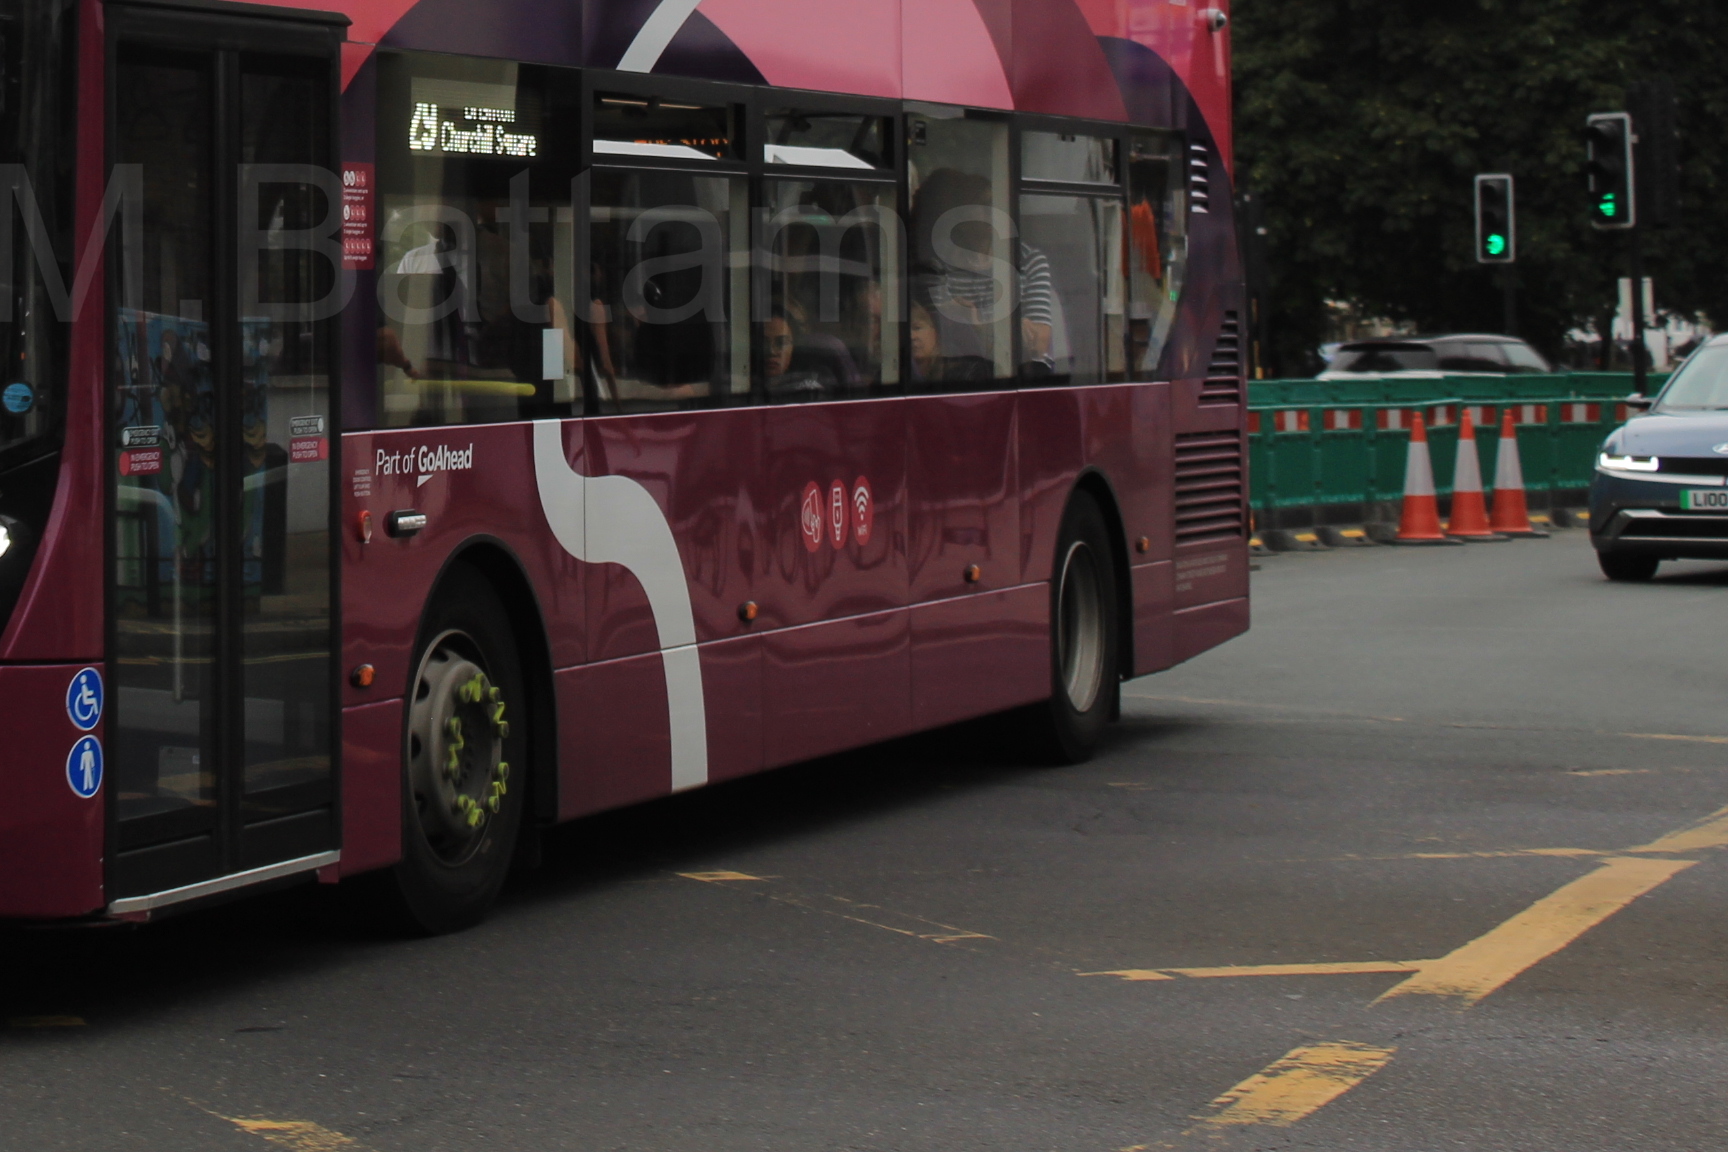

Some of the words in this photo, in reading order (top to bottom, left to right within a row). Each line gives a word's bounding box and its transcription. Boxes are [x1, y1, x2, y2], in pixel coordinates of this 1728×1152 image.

[375, 448, 401, 476] Part
[402, 446, 416, 474] of
[417, 442, 474, 473] GoAhead
